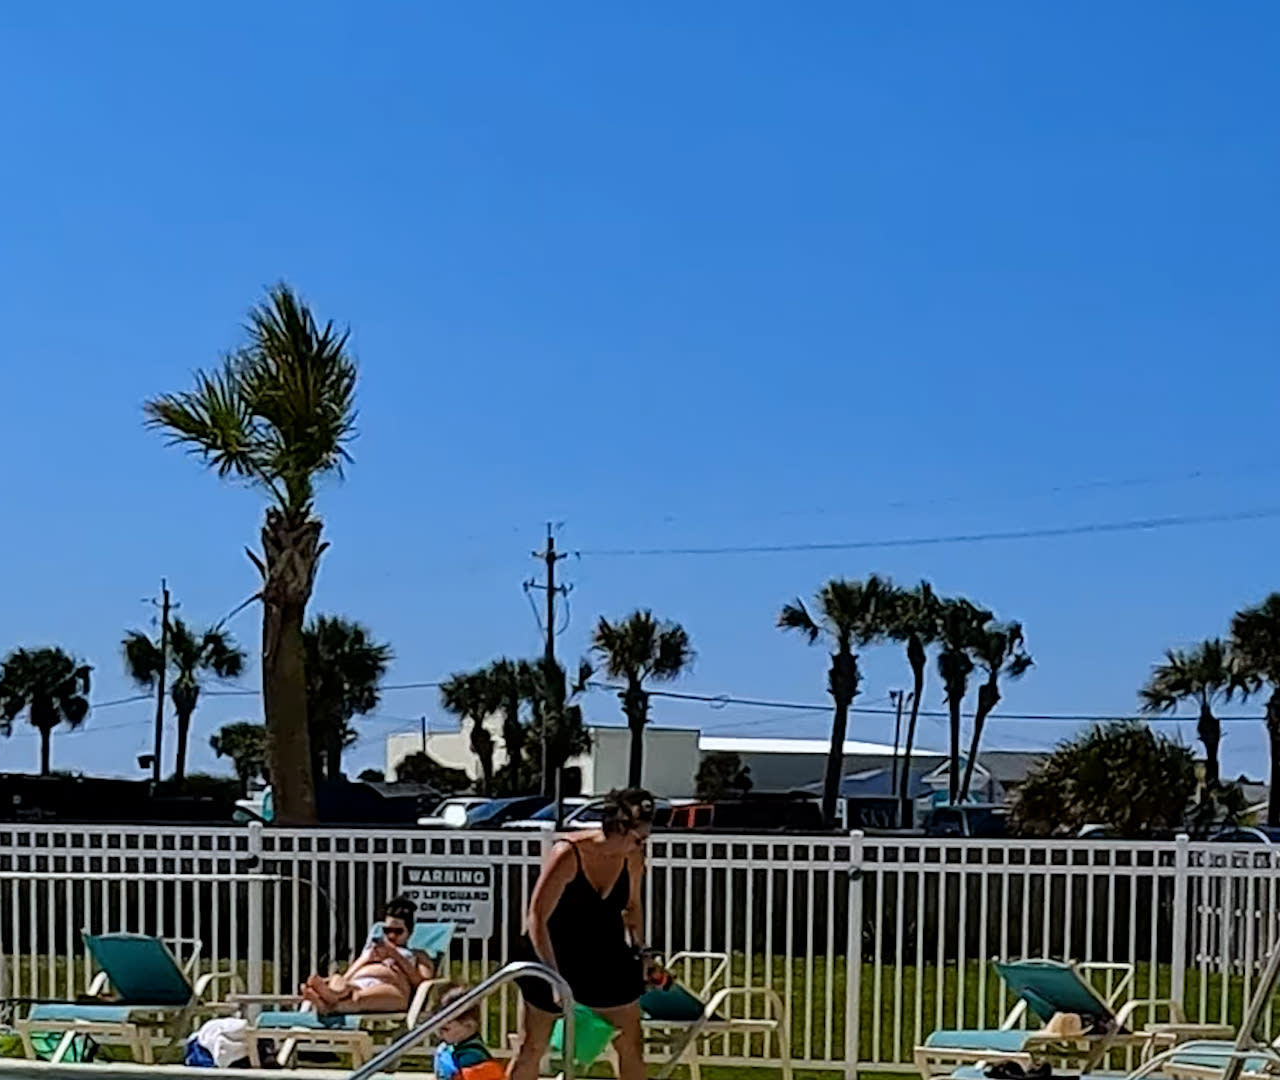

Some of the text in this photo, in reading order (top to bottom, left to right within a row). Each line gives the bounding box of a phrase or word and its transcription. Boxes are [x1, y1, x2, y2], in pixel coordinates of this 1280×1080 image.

[408, 869, 485, 884] WARNING
[423, 890, 489, 901] LIFEGUARD
[420, 902, 472, 913] ON DUTY
